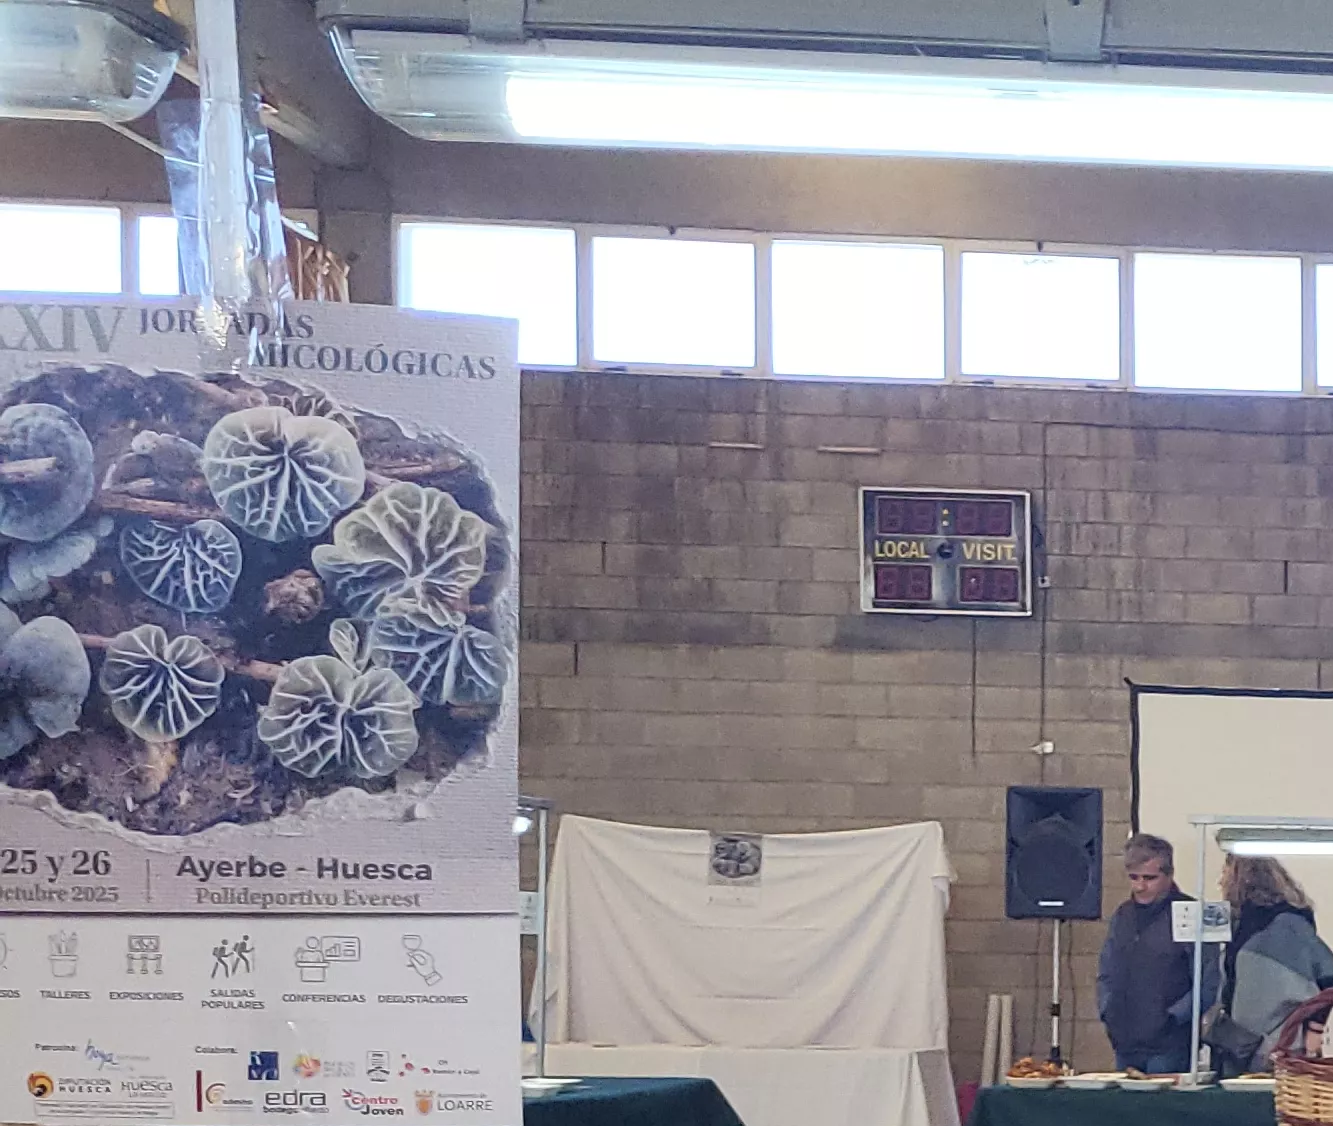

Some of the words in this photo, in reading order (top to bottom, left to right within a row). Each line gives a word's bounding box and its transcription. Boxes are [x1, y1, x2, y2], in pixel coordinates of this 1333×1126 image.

[874, 540, 931, 559] LOCAL
[1, 849, 37, 876] 25
[46, 853, 65, 882] y
[71, 849, 112, 876] 26
[177, 855, 286, 882] Ayerbe
[316, 856, 433, 881] Huesca
[71, 885, 120, 902] 2025
[196, 886, 338, 909] Polideportivo
[343, 889, 422, 908] Everest
[41, 990, 91, 1000] TALLERES
[282, 993, 366, 1004] CONFERENCIAS
[377, 994, 469, 1004] DEGUSTACIONES
[201, 1000, 265, 1010] POPULARES
[265, 1089, 326, 1107] edra
[437, 1099, 494, 1112] LOARRE
[361, 1104, 405, 1117] Joven
